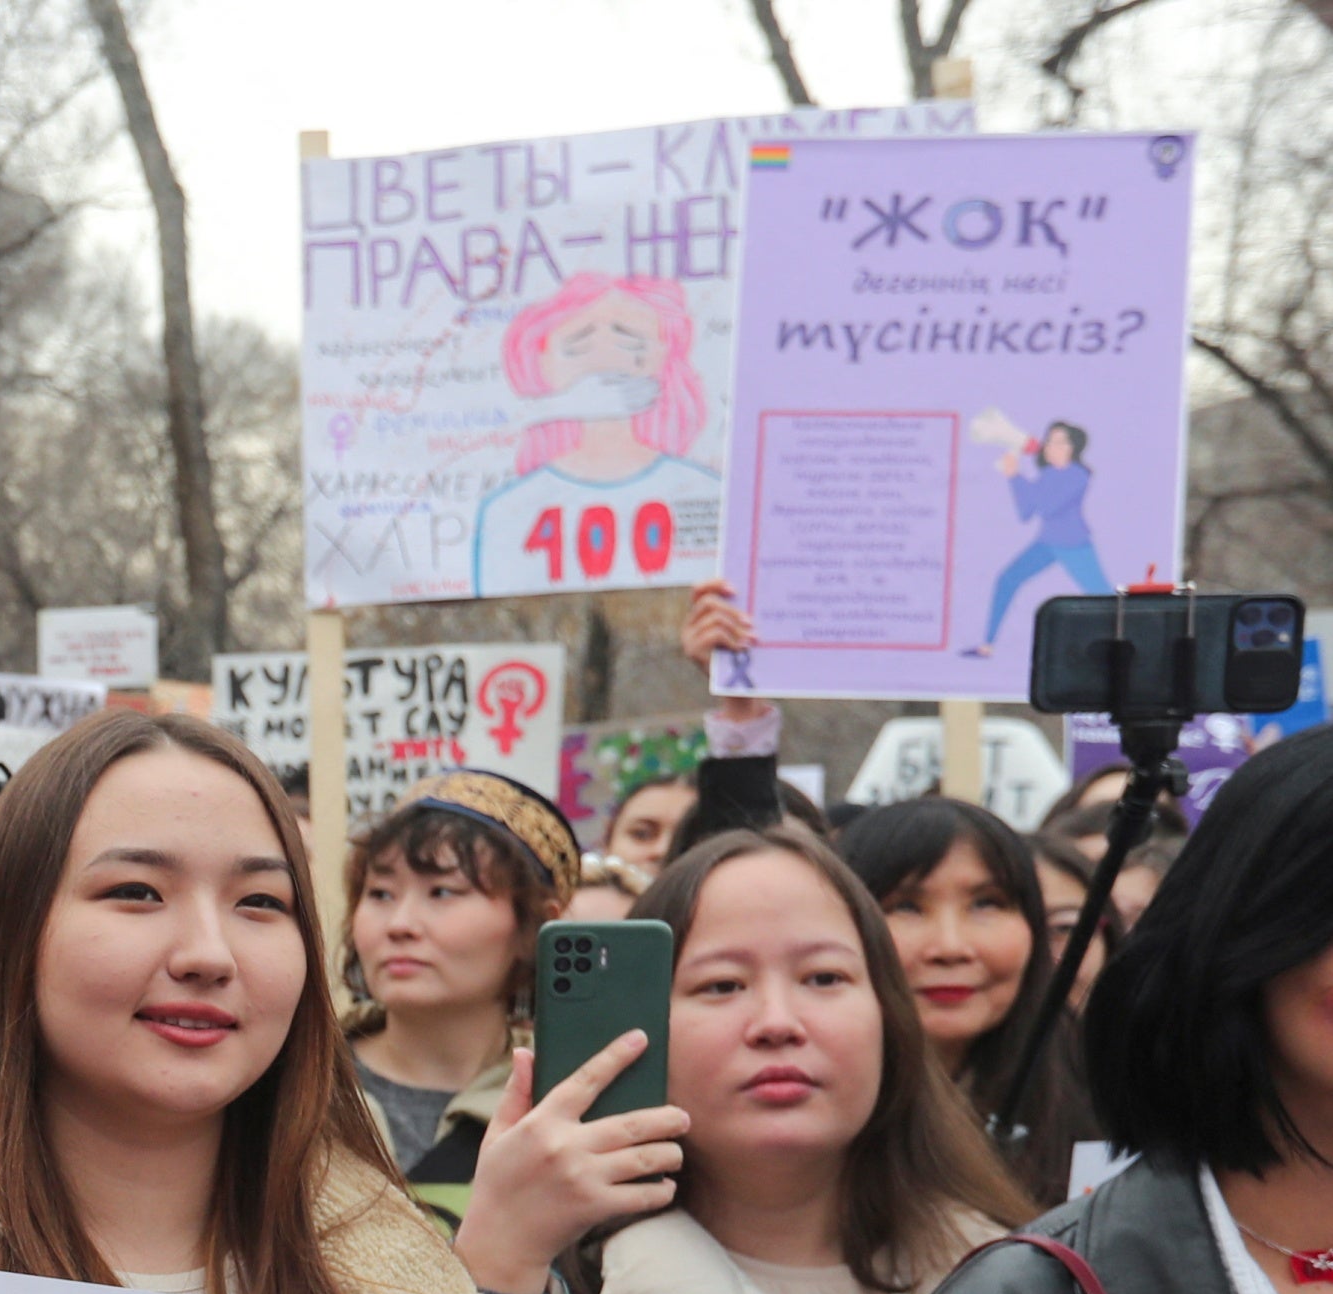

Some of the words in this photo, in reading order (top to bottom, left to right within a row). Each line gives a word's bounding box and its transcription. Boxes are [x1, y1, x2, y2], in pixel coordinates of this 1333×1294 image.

[301, 141, 571, 235] ЦВЕТЫ
[304, 218, 564, 309] ПРАВА
[777, 307, 1145, 363] түсініксіз?
[229, 654, 468, 712] КУТУРА
[264, 710, 381, 740] МОТ
